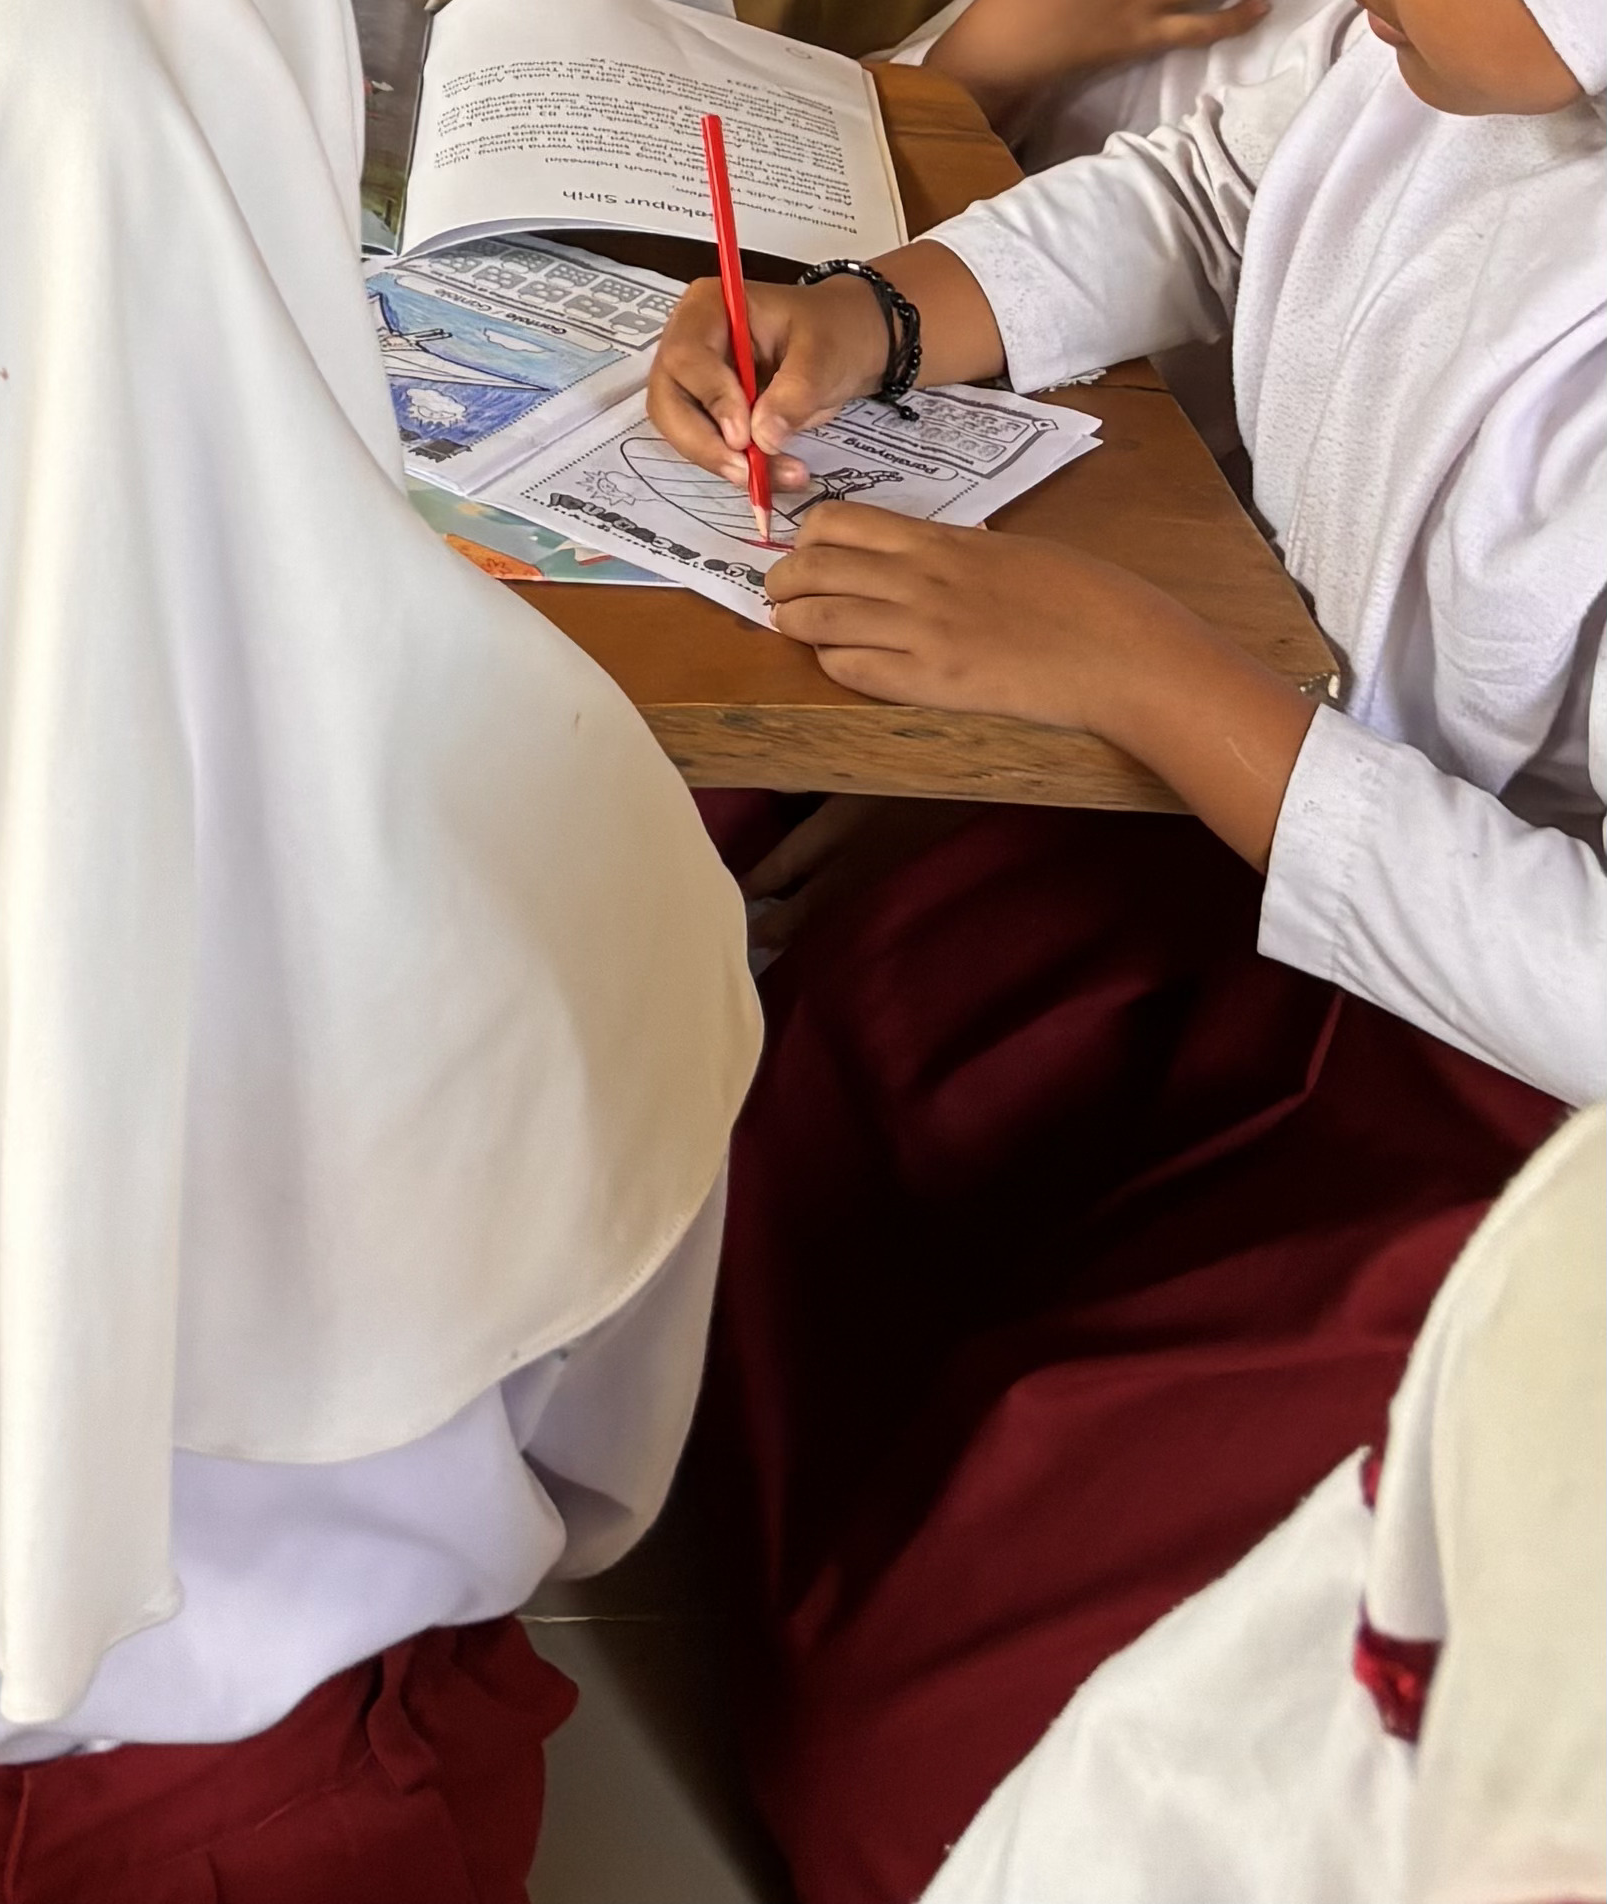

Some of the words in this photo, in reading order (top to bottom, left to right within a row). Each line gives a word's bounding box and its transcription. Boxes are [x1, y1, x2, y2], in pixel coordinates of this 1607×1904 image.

[563, 190, 617, 204] Sirih
[504, 311, 568, 337] Gantole
[842, 438, 940, 476] Paralayang
